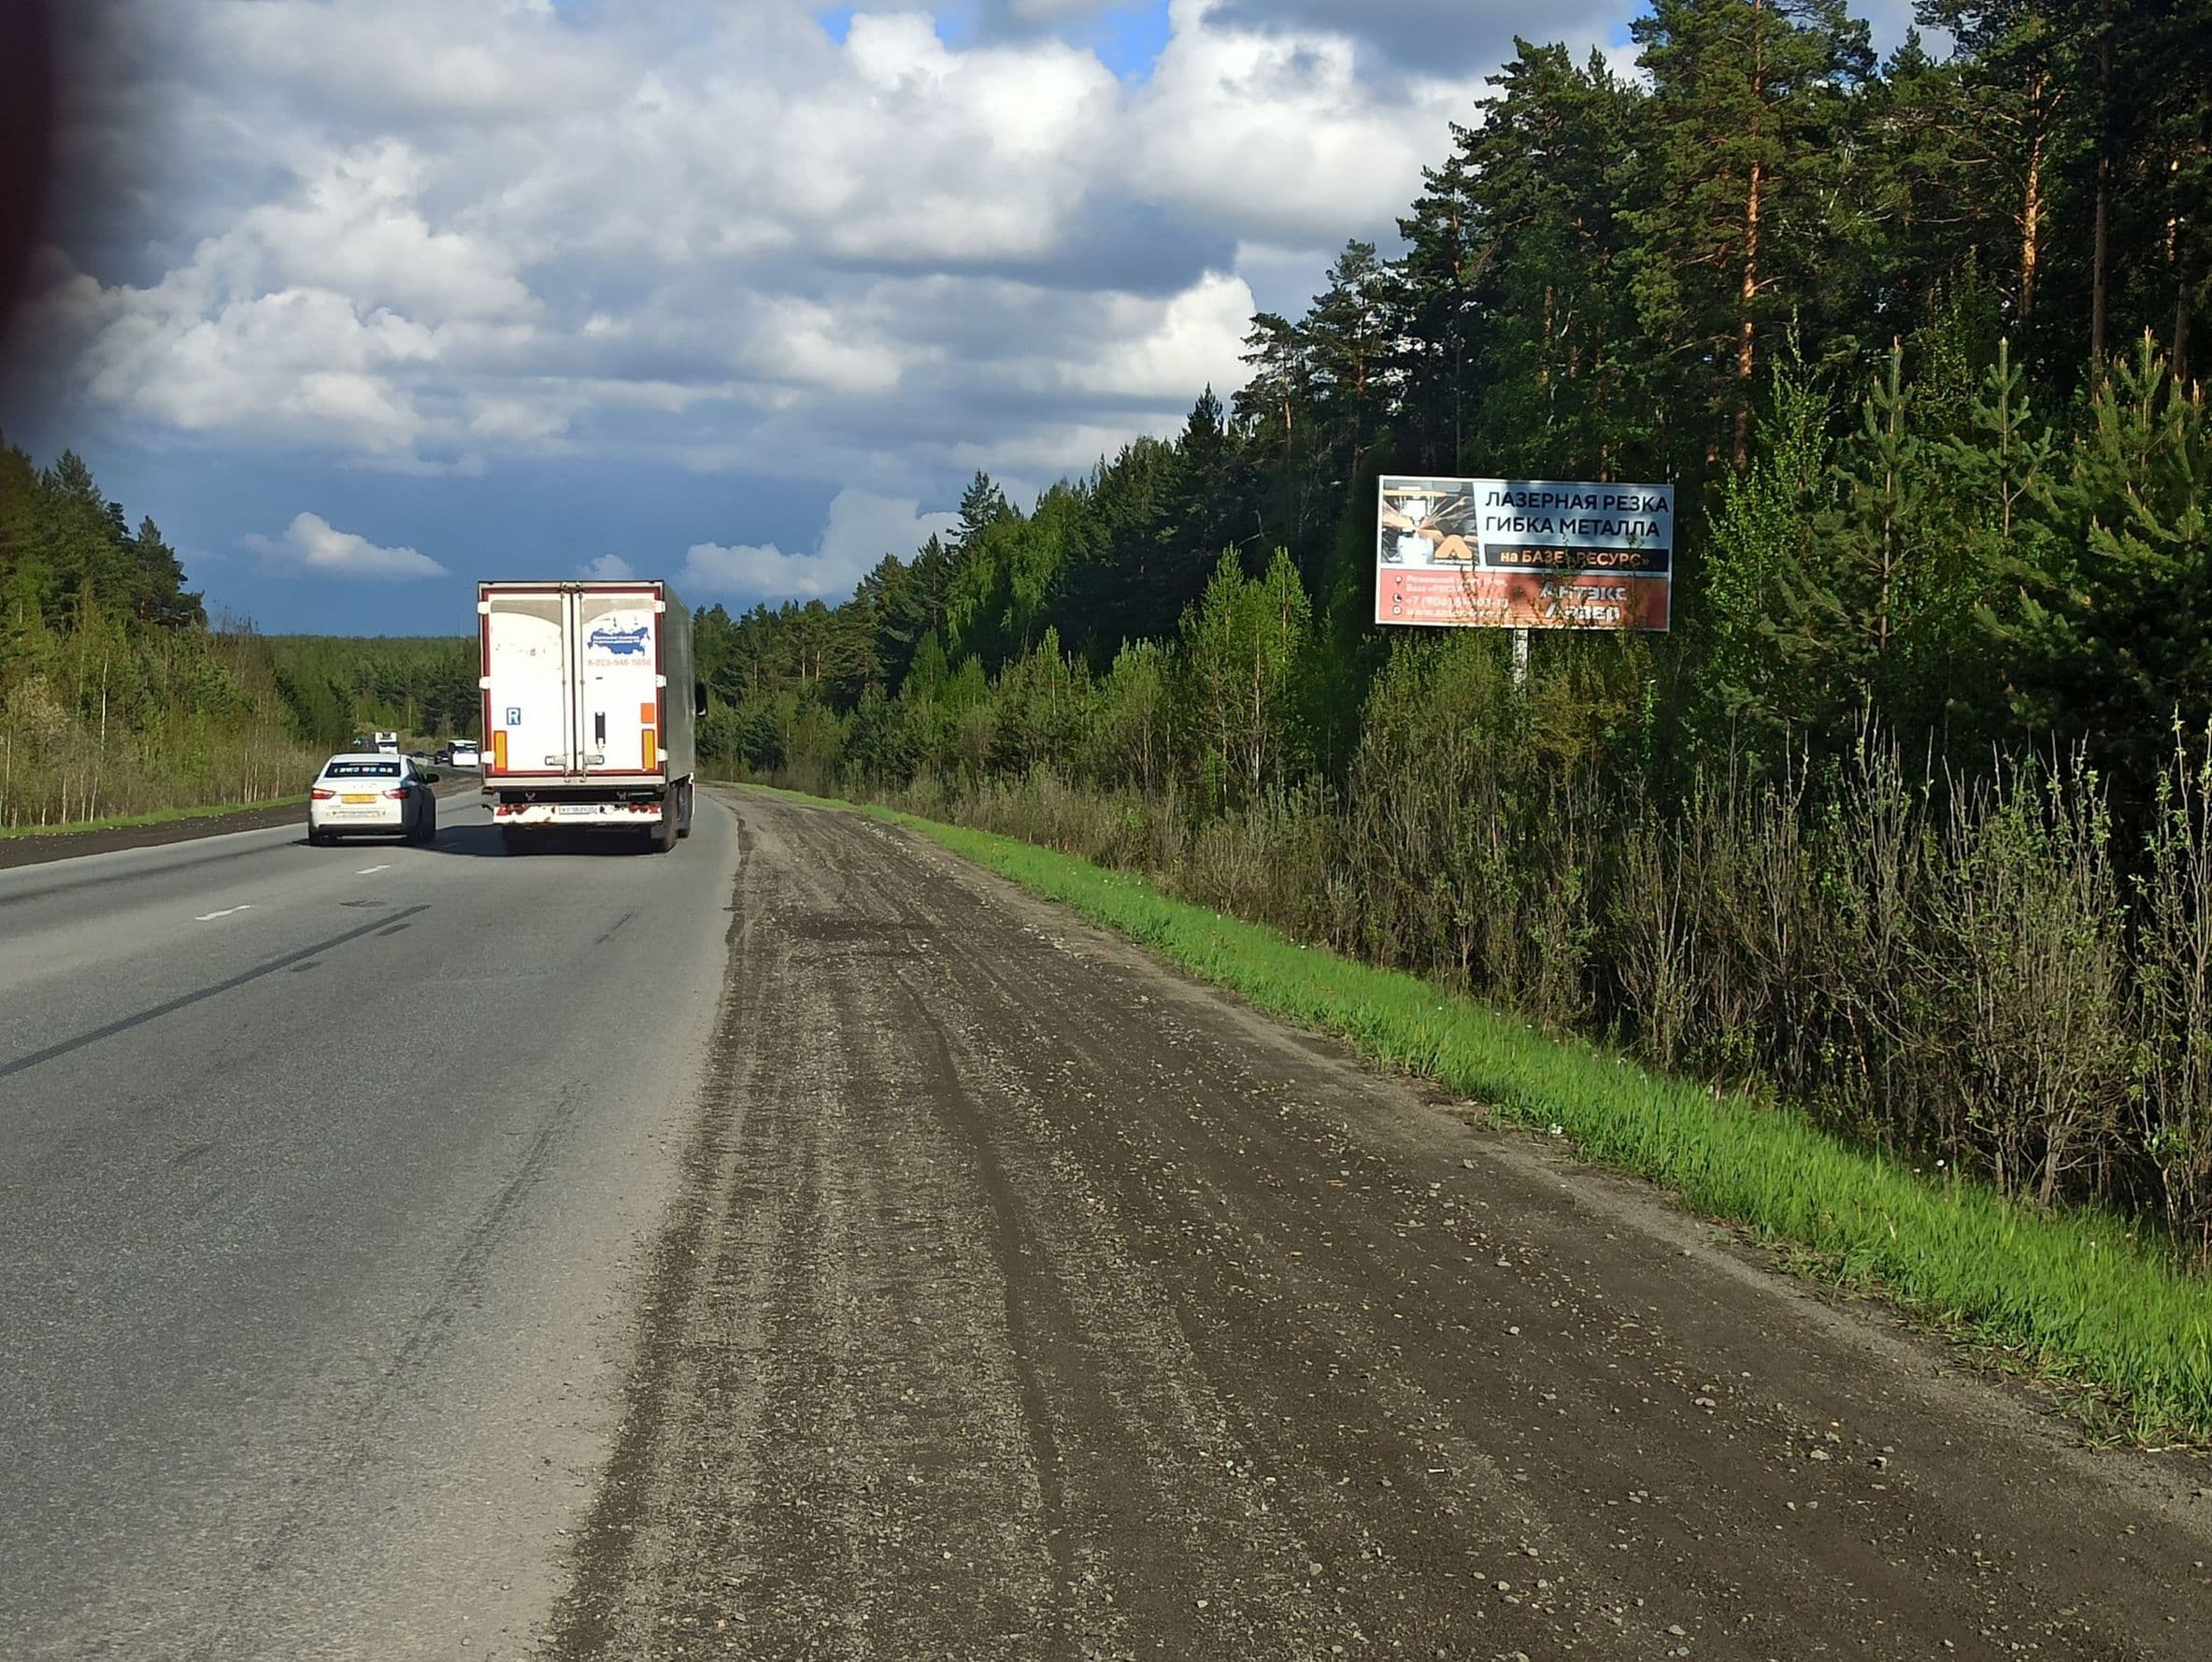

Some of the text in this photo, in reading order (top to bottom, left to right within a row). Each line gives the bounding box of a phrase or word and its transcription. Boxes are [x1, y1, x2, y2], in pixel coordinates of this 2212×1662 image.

[1485, 492, 1669, 513] ЛАЗЕРНАЯ РЕЗКА
[1486, 516, 1661, 537] ГИБКА МЕТАЛЛА
[1500, 551, 1519, 563] на
[1521, 550, 1564, 564] БАЗЕ
[508, 709, 521, 724] R
